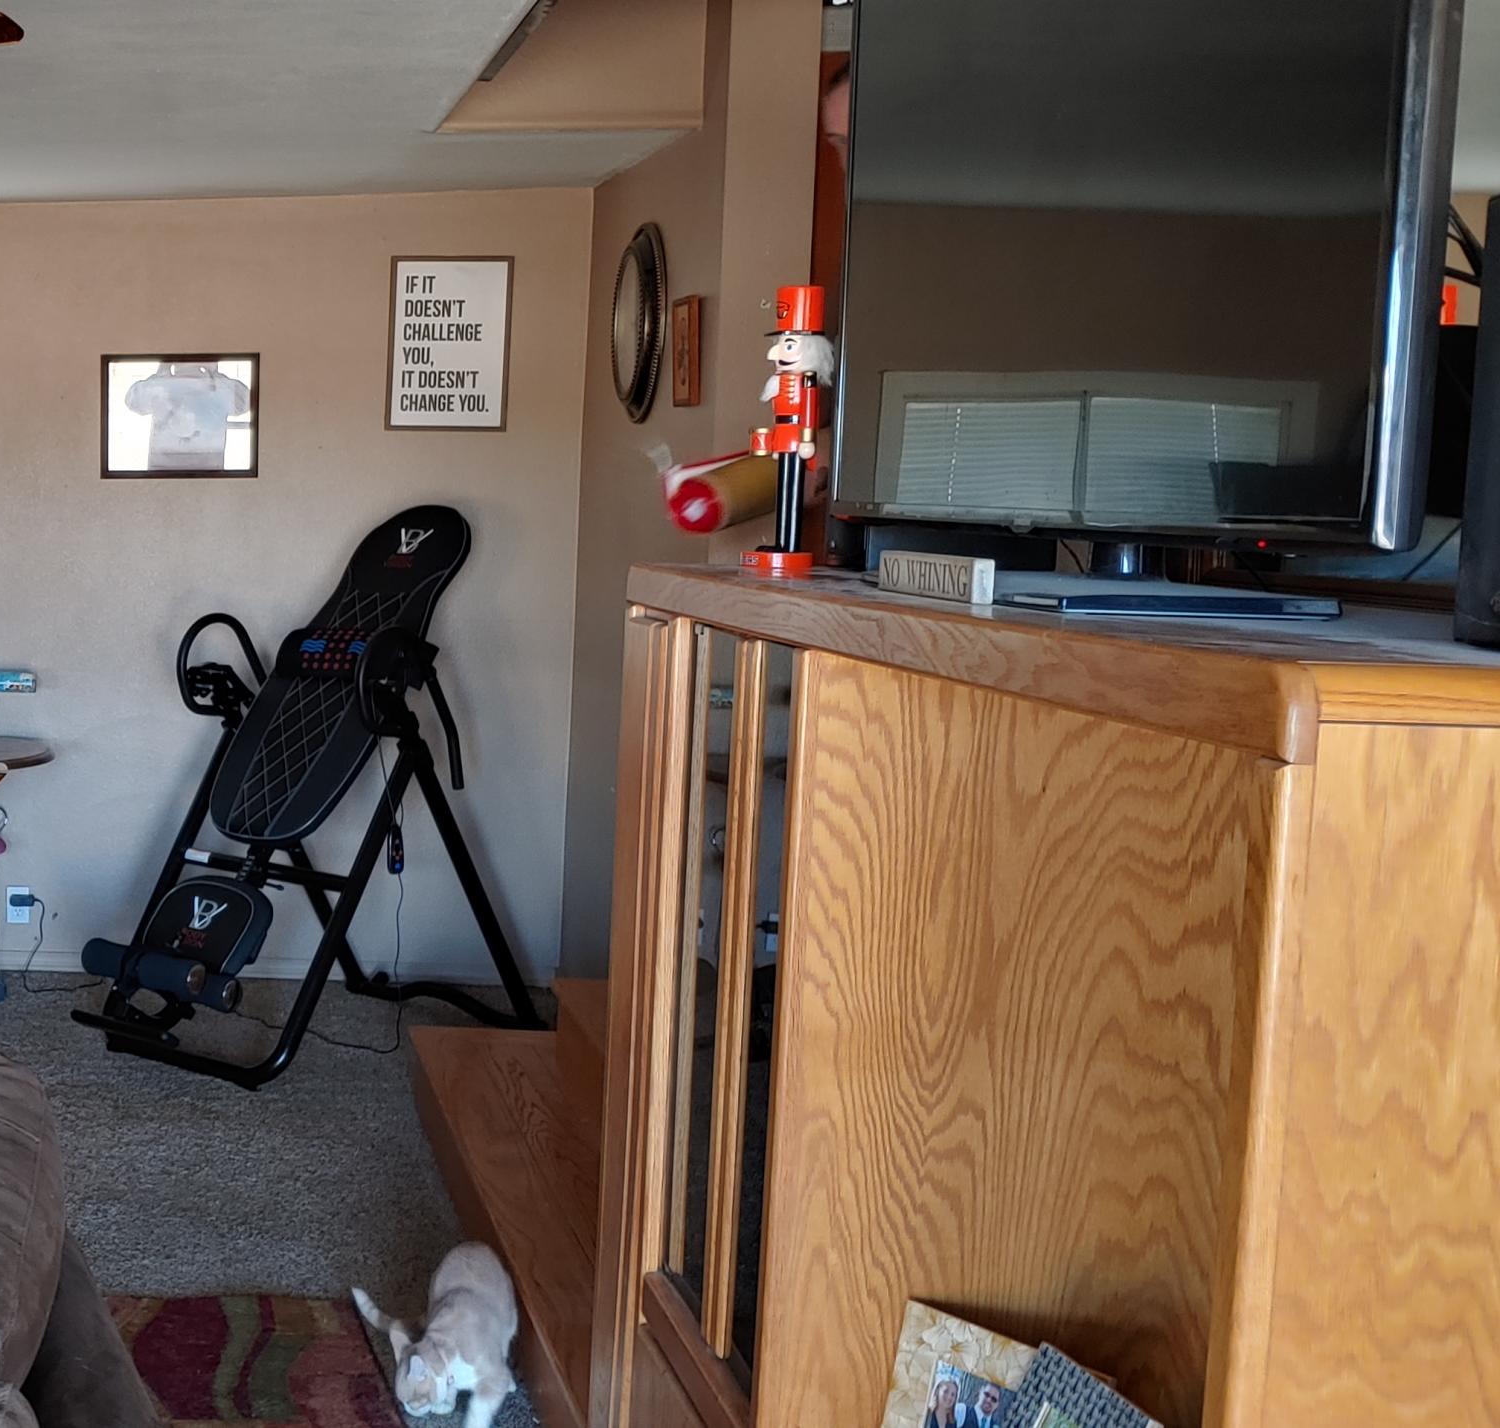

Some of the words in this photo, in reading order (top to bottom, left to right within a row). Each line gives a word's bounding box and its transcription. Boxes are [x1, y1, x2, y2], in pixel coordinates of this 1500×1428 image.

[405, 275, 419, 294] IF
[422, 275, 436, 294] IT
[405, 299, 466, 317] DOESN'T
[403, 323, 482, 341] CHALLENGE
[402, 347, 434, 367] YOU,
[401, 370, 415, 388] IT
[418, 371, 479, 389] DOESN'T
[400, 394, 455, 412] CHANGE
[459, 394, 489, 412] YOU.
[882, 557, 900, 587] NO
[906, 559, 968, 597] WHINING
